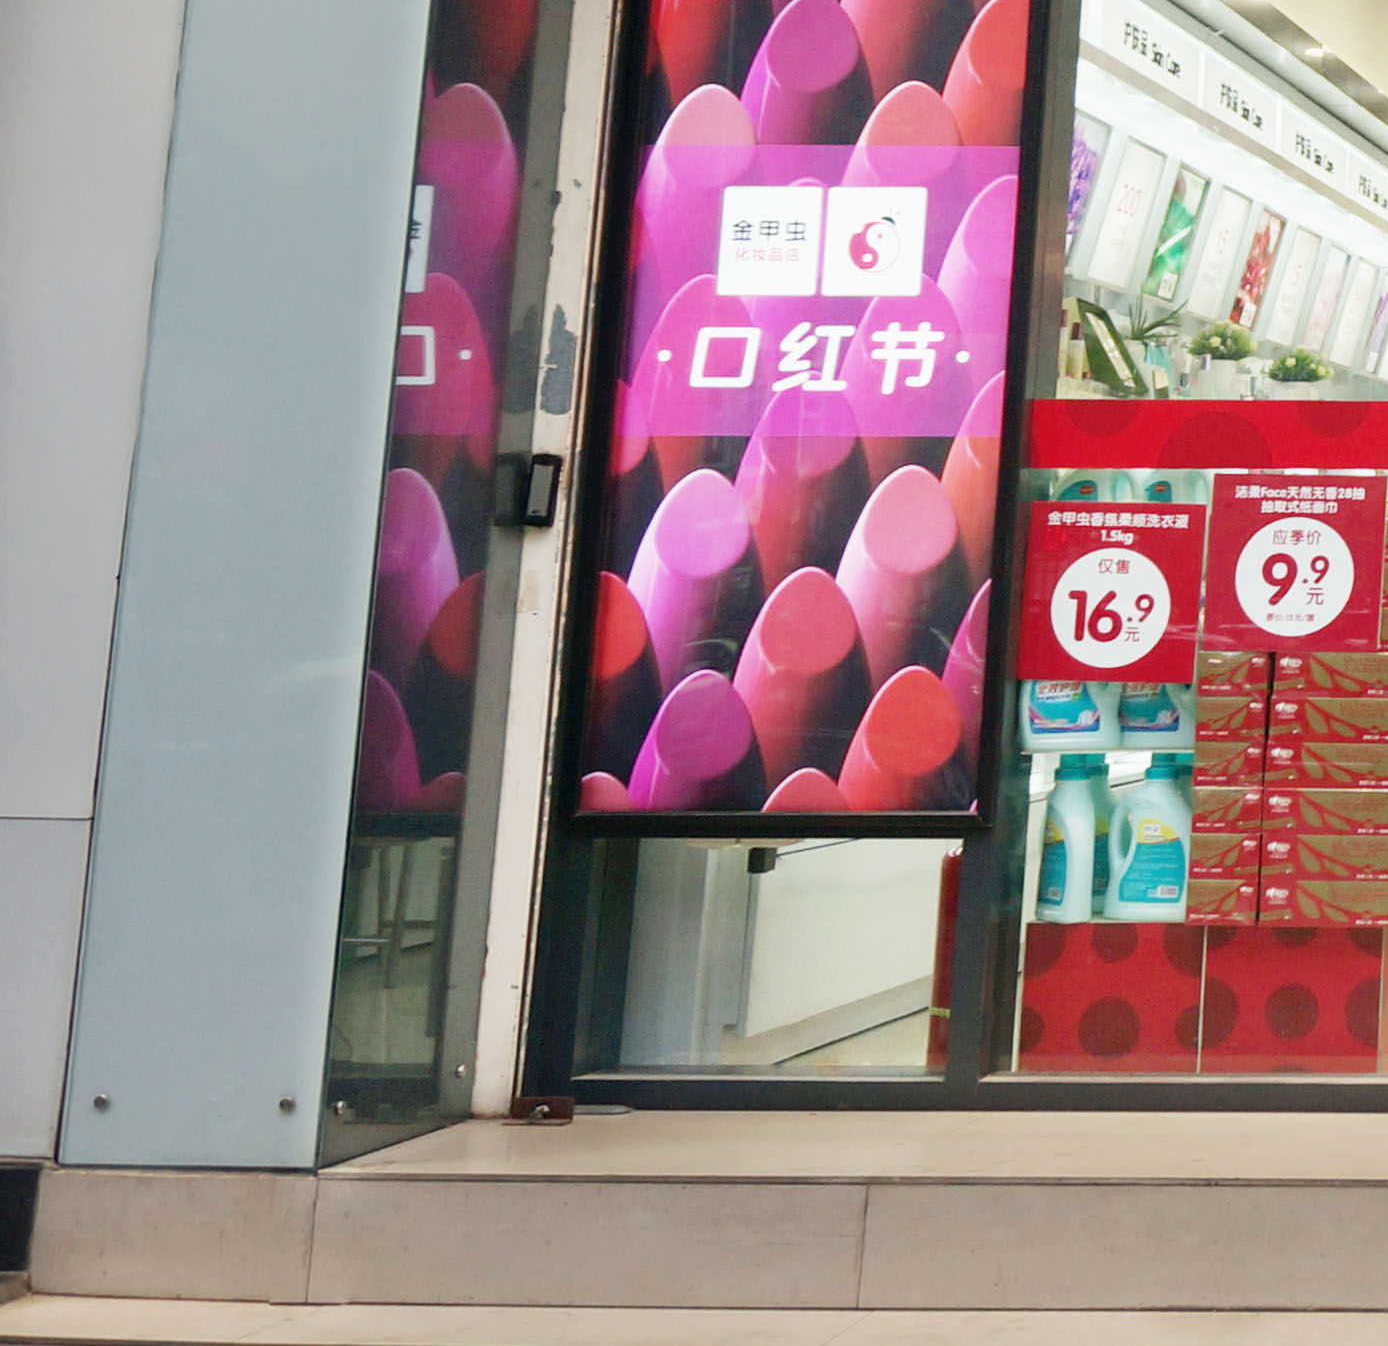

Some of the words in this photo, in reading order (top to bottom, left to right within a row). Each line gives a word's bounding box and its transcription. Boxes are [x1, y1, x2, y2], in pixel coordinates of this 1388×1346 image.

[732, 219, 806, 243] 金甲虫
[735, 248, 799, 262] 化妆品店
[689, 321, 946, 395] 口红节
[1100, 529, 1134, 545] 1.5kg
[1272, 530, 1322, 545] 应季价
[1098, 558, 1130, 574] 仅售
[1306, 588, 1324, 606] 元
[1123, 627, 1140, 643] 元
